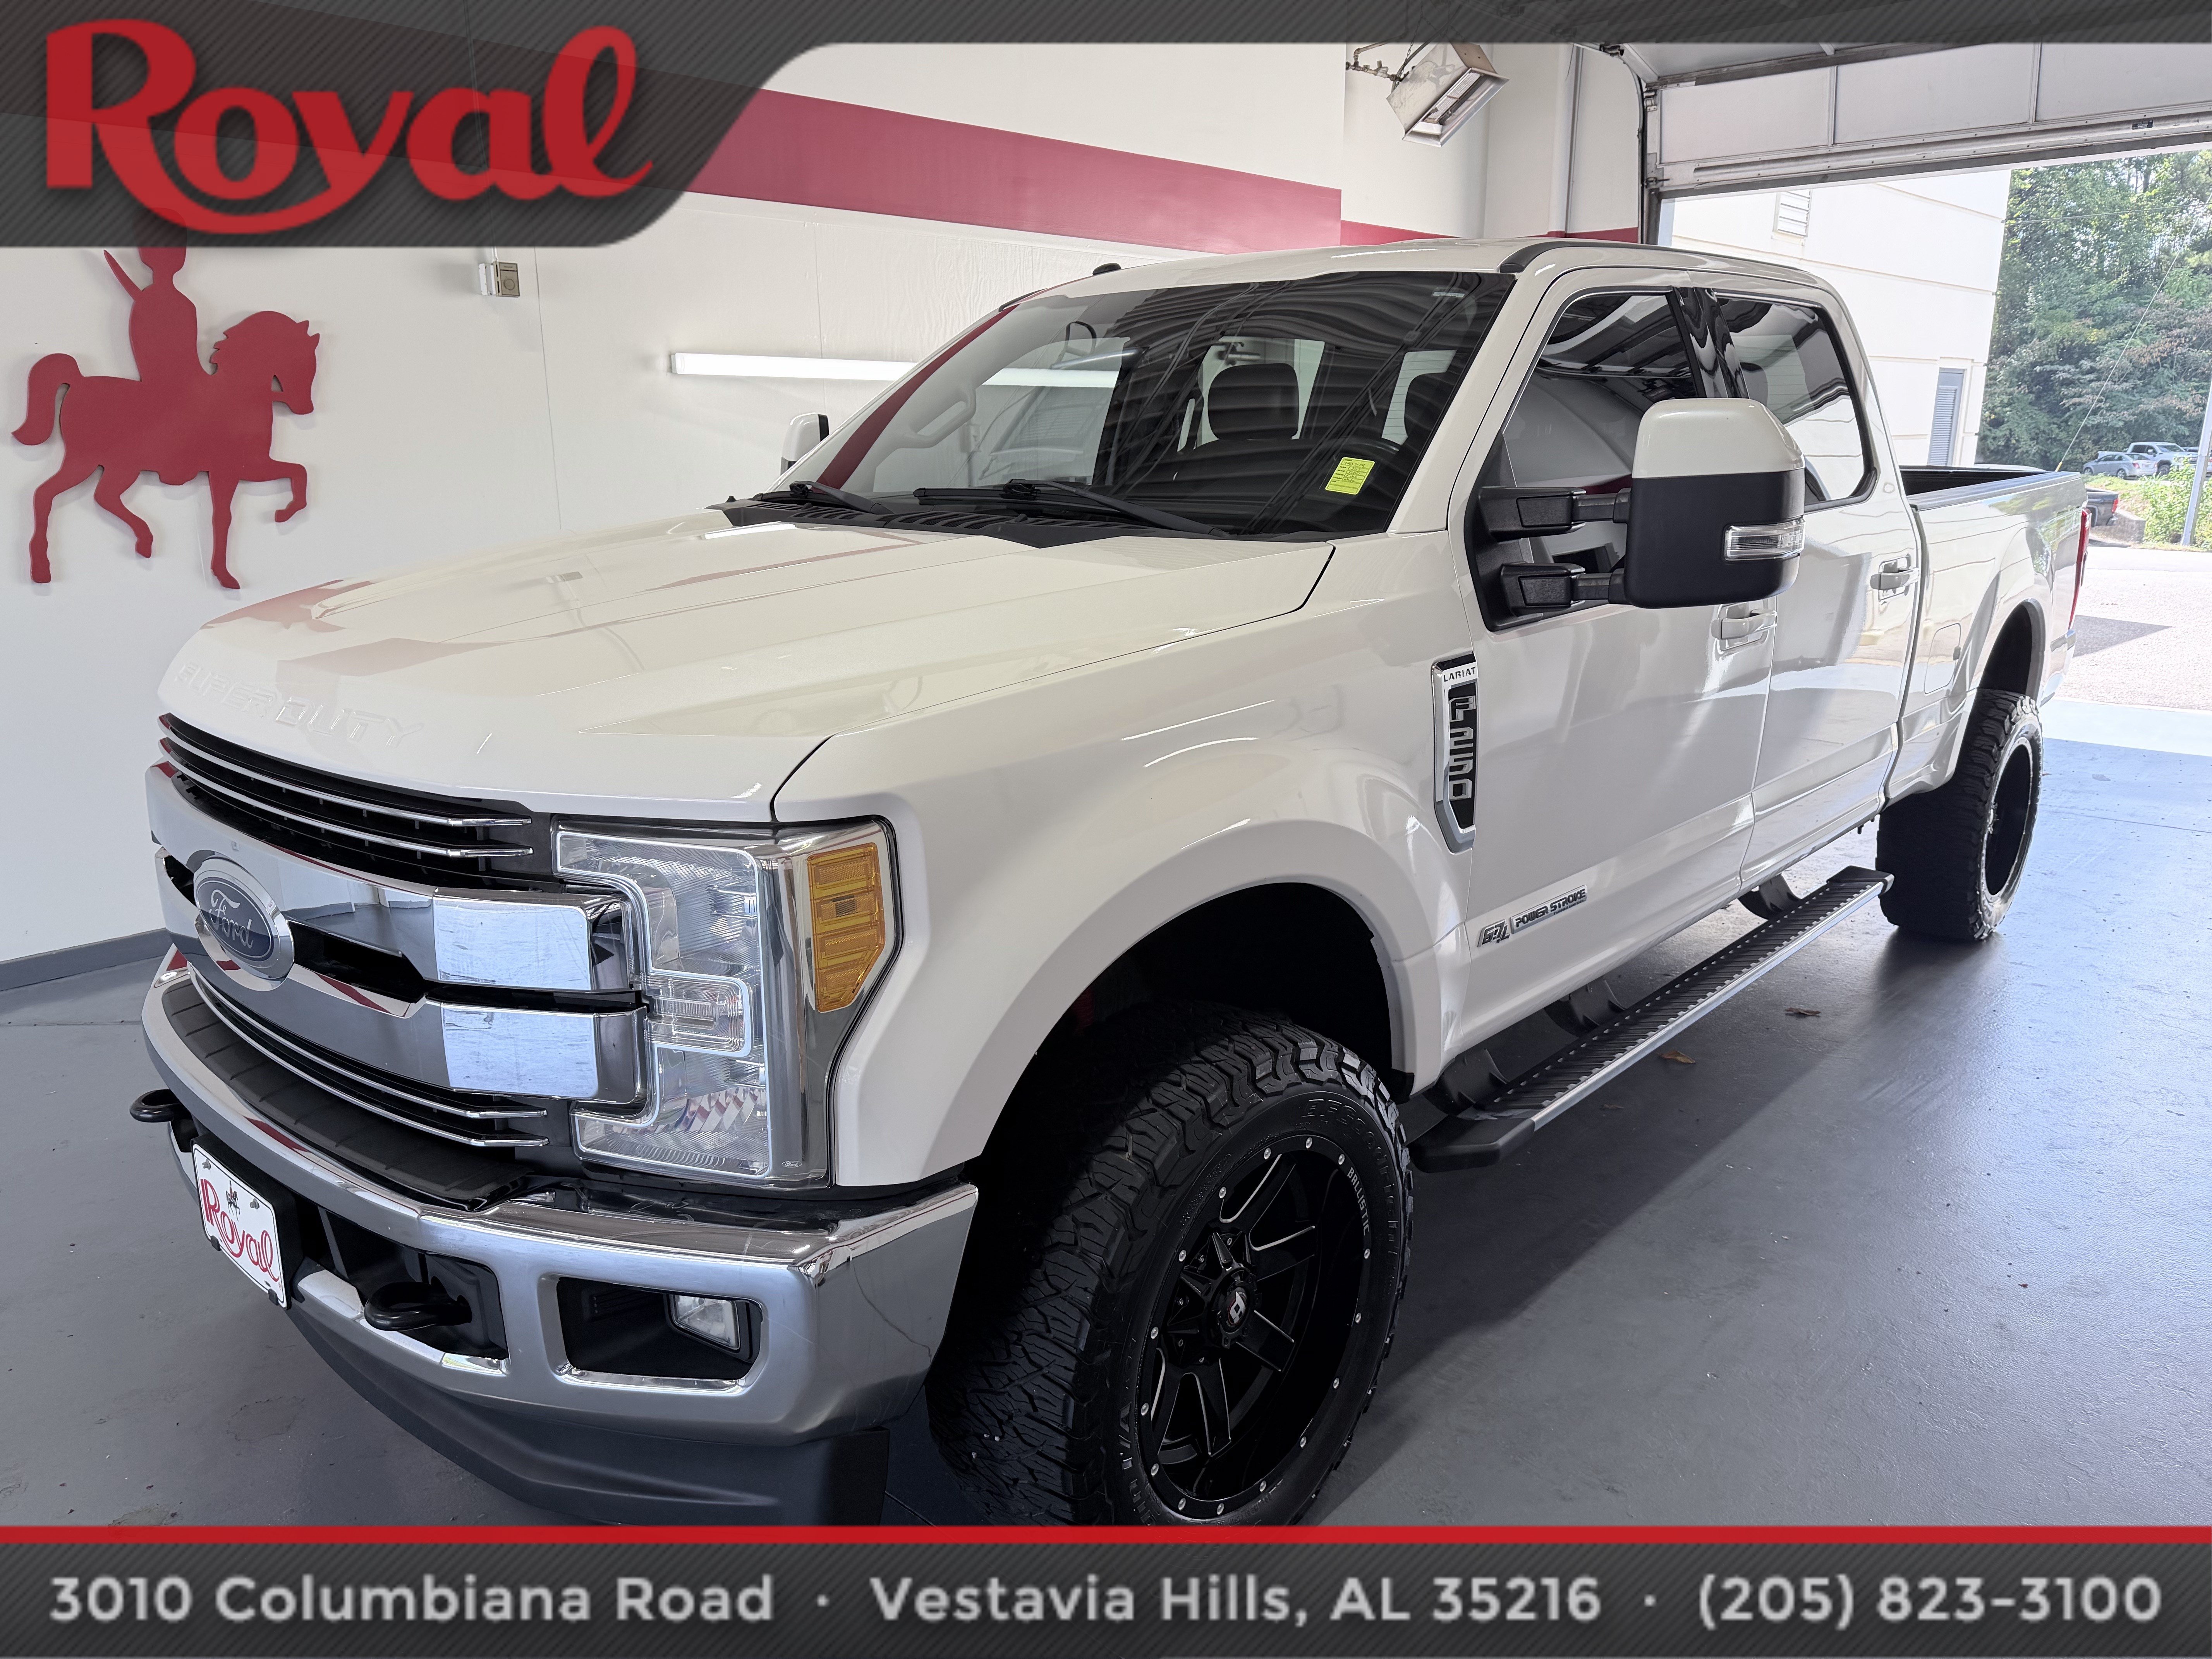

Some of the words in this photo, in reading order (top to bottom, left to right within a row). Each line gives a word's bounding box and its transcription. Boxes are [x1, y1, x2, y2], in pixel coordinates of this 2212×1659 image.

[174, 661, 282, 717] SUPER
[275, 696, 425, 748] DUTY
[1443, 666, 1477, 682] LARIAT
[209, 889, 253, 949] Ford
[1515, 906, 1549, 927] POWER
[1550, 888, 1586, 912] STROKE
[201, 1179, 279, 1282] Royal
[1347, 1166, 1370, 1237] BALLISTIC
